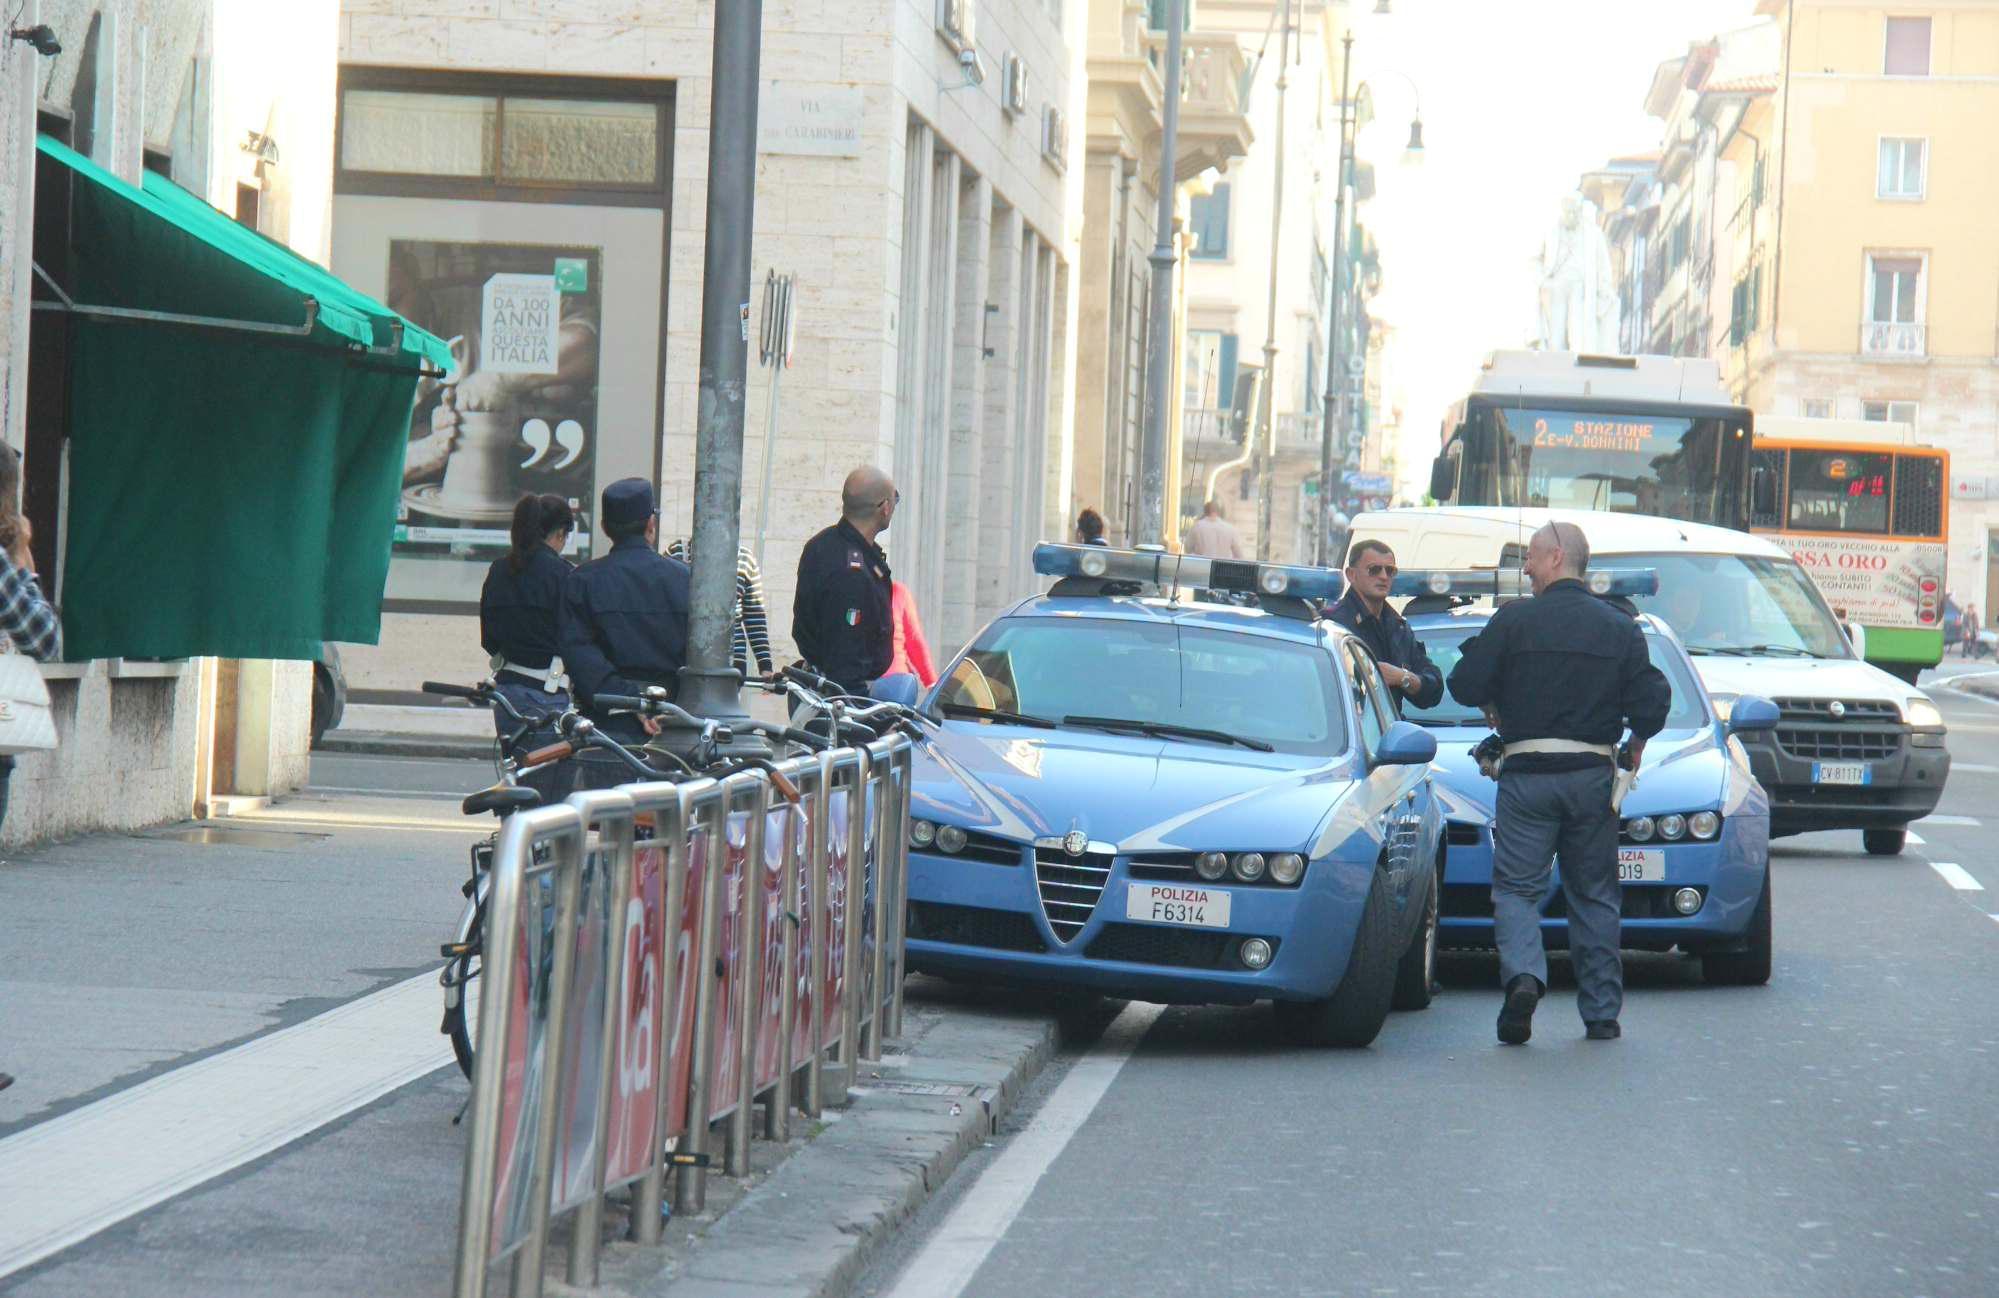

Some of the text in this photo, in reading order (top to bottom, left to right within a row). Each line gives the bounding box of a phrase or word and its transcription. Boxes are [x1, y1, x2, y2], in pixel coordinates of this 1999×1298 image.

[494, 296, 550, 312] DA 100
[493, 310, 550, 328] ANNI
[491, 334, 549, 348] QUESTA
[491, 346, 550, 364] ITALIA
[1534, 418, 1654, 449] 2 STAZIONE
[1830, 458, 1848, 480] 2
[1838, 553, 1888, 571] ORO
[1151, 886, 1209, 903] POLIZIA
[1151, 901, 1206, 924] F6314
